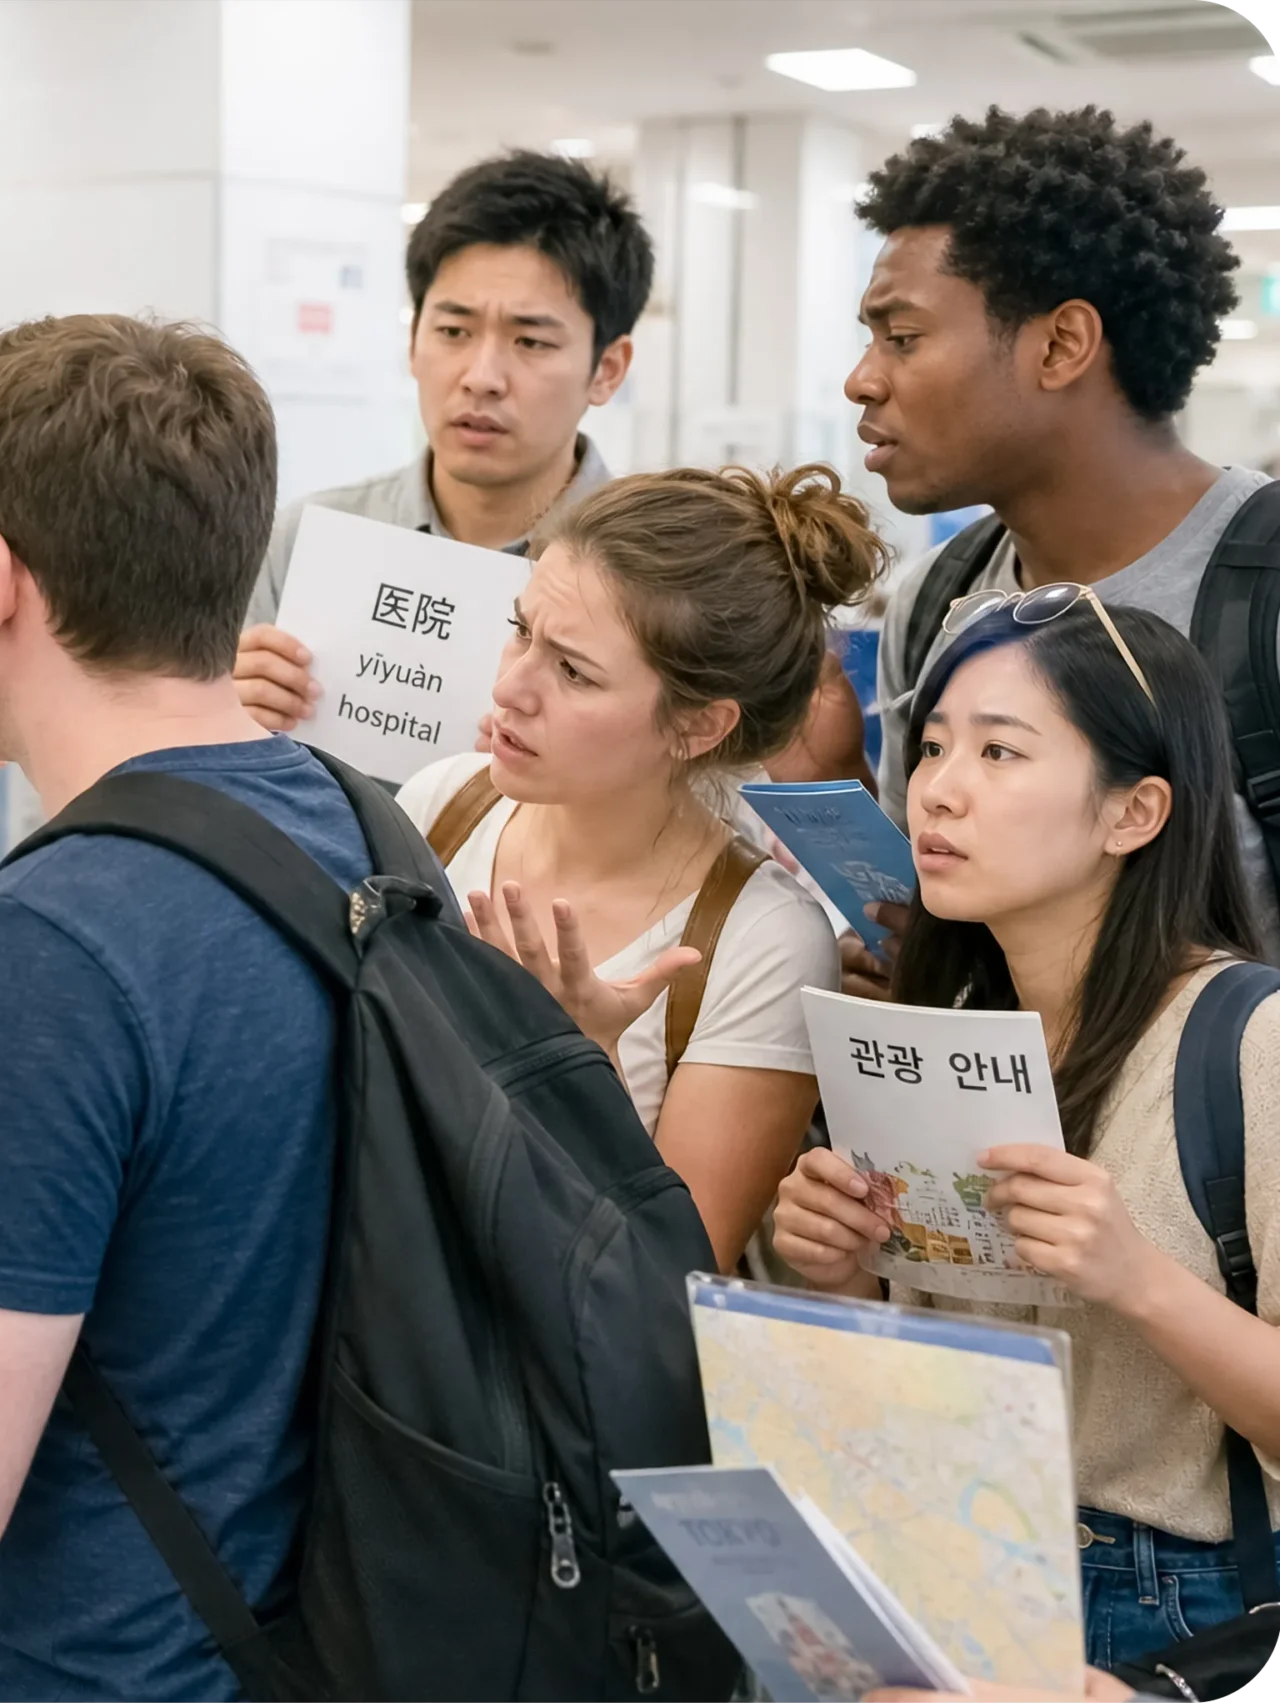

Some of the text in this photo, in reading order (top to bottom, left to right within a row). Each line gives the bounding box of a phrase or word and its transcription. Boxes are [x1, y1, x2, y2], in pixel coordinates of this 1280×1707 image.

[371, 582, 456, 641] 医院
[338, 693, 442, 745] hospital
[848, 1036, 1032, 1094] 관광 안내
